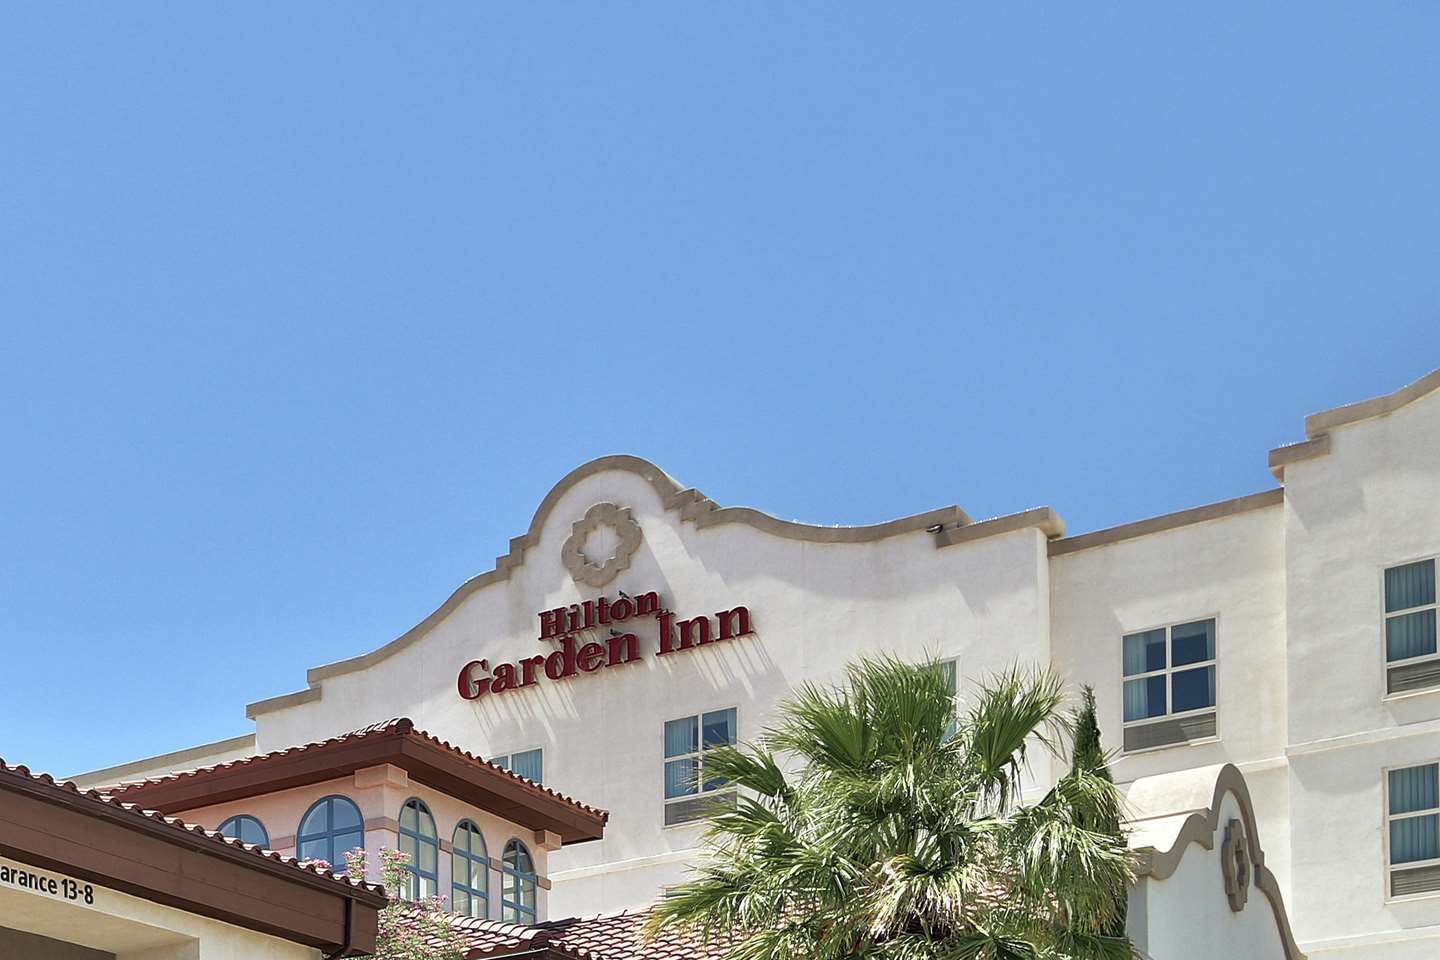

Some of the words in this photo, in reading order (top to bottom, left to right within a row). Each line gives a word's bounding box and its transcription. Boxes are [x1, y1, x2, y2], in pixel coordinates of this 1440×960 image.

[538, 590, 661, 641] Hilton
[457, 632, 643, 701] Garden
[655, 604, 755, 656] Inn
[61, 878, 94, 905] 13-8
